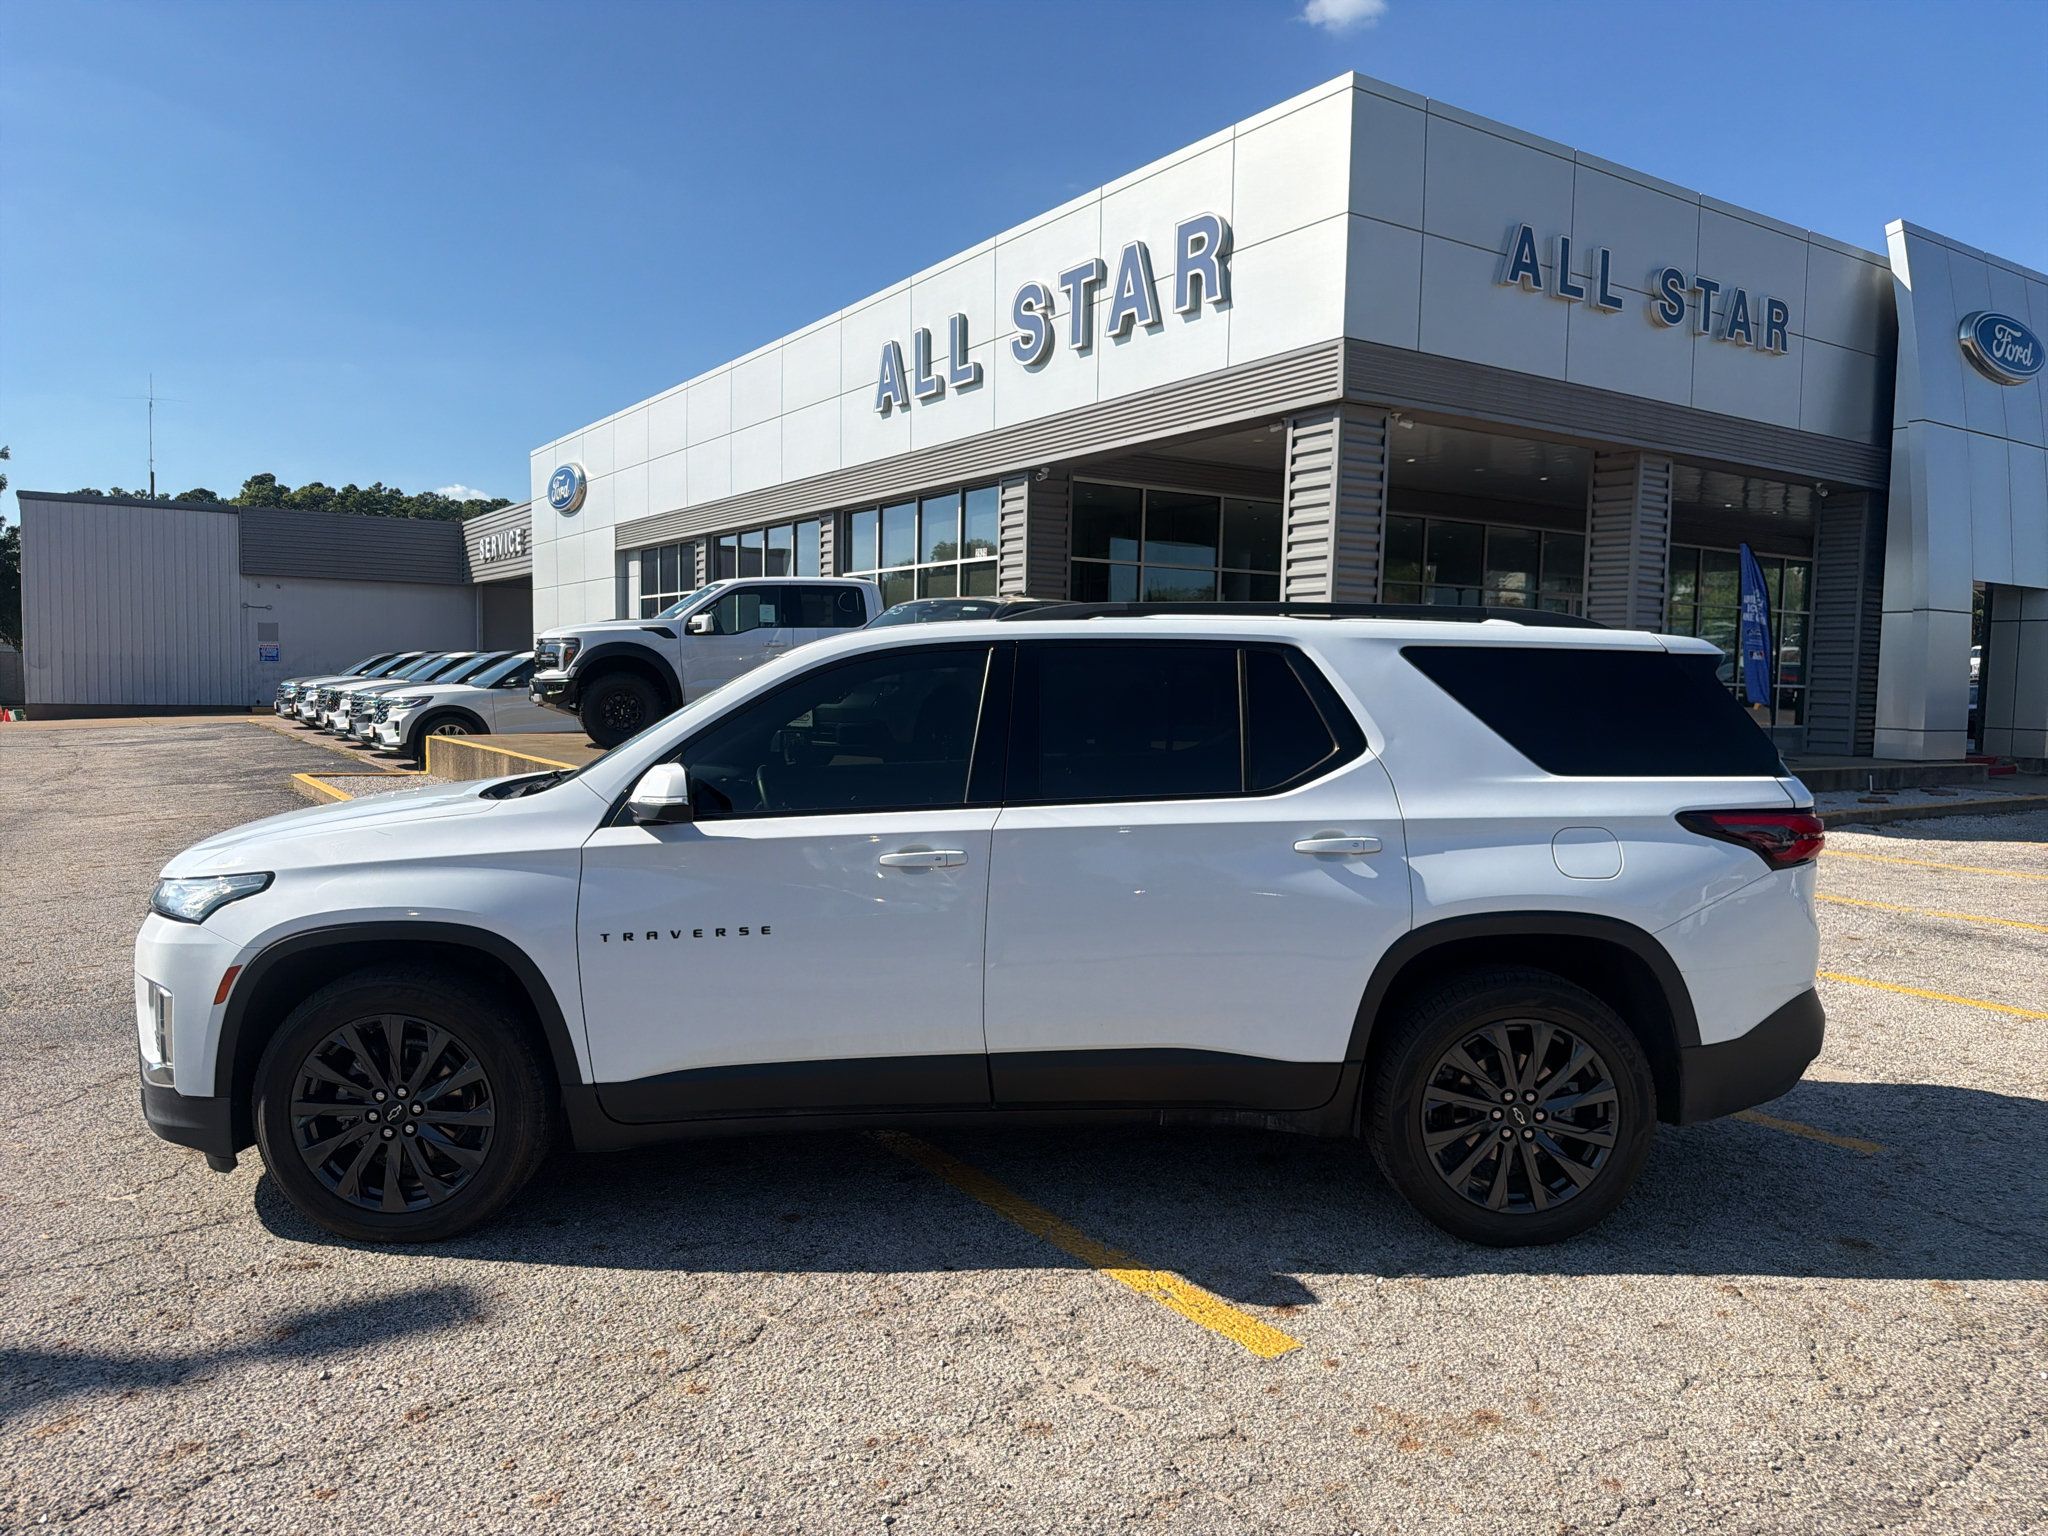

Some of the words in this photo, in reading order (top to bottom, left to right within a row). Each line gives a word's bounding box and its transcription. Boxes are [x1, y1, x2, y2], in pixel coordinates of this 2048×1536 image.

[1504, 223, 1624, 312] ALL
[1650, 265, 1790, 355] STAR
[874, 312, 981, 414] ALL
[1010, 211, 1231, 369] STAR
[1992, 323, 2034, 367] Ford
[479, 528, 523, 561] SERVICE
[599, 925, 772, 943] TRAVERSE
